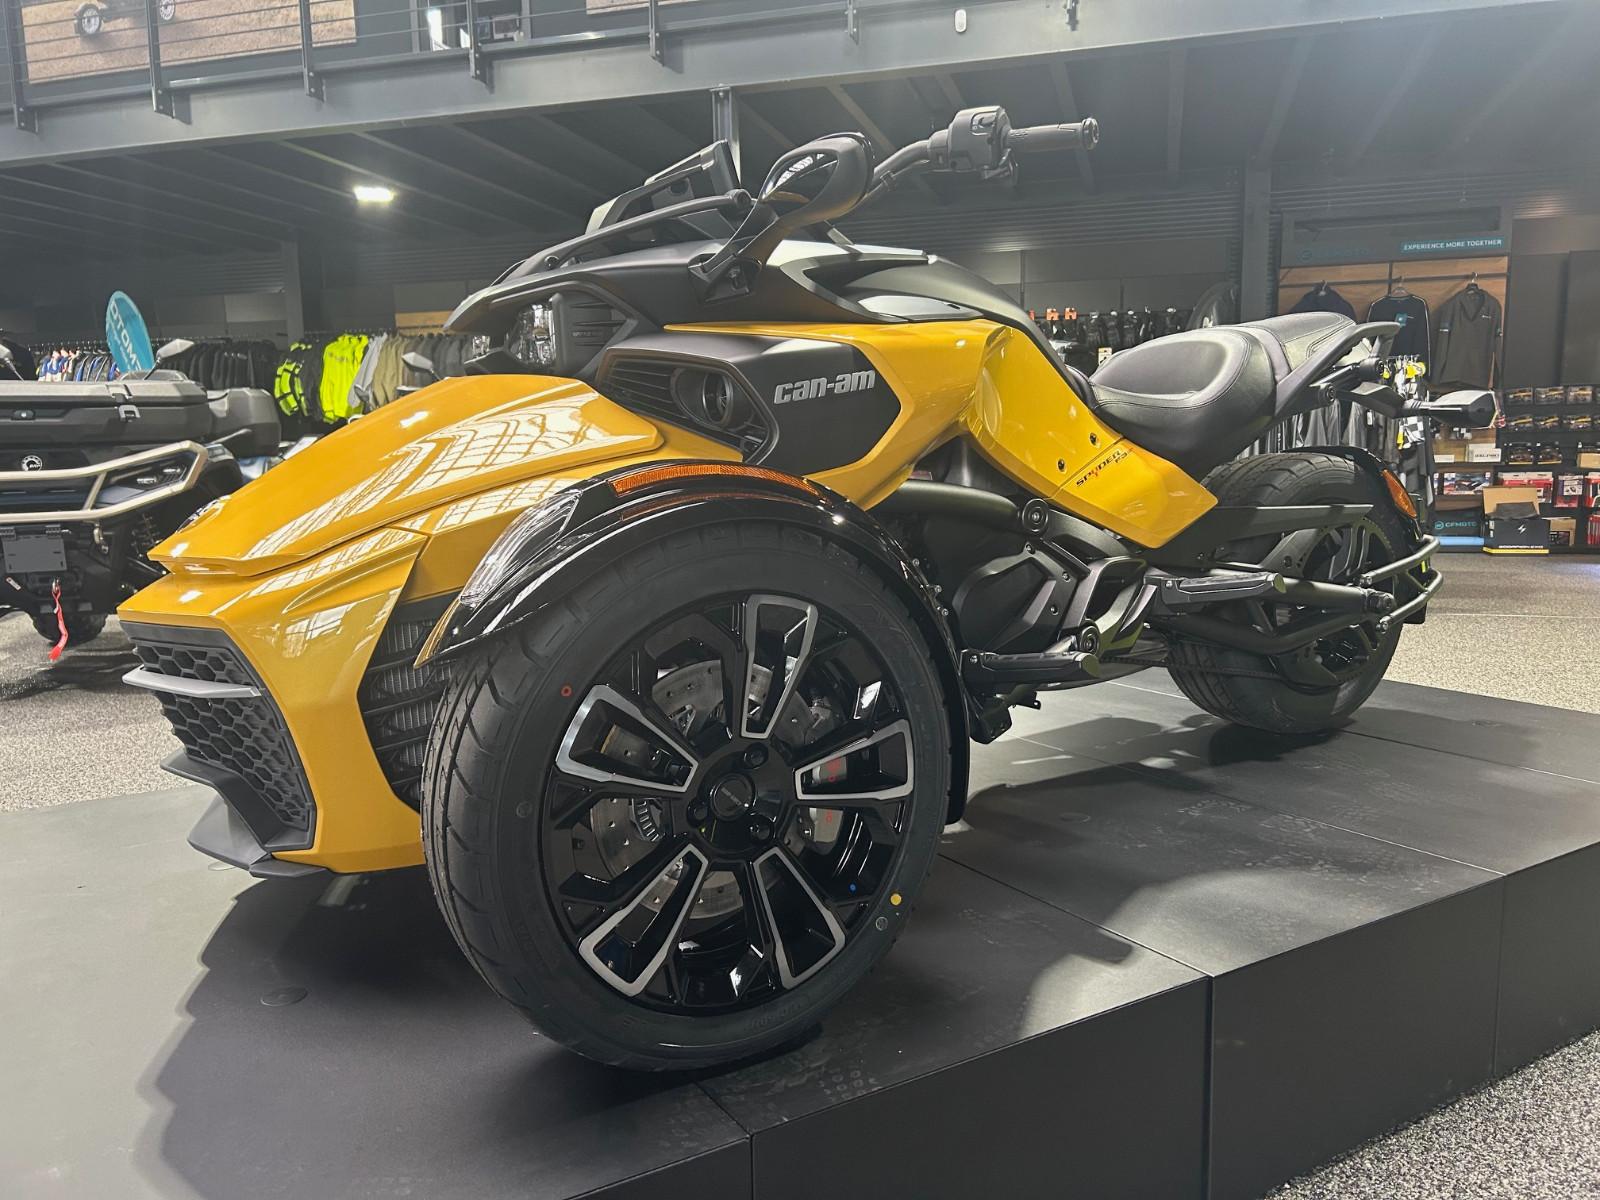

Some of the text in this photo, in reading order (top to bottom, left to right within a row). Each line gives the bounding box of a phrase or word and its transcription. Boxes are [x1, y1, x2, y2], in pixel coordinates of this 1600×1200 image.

[1467, 239, 1502, 247] TOGETHER
[774, 370, 876, 404] can-am
[1076, 450, 1121, 486] SPYDER
